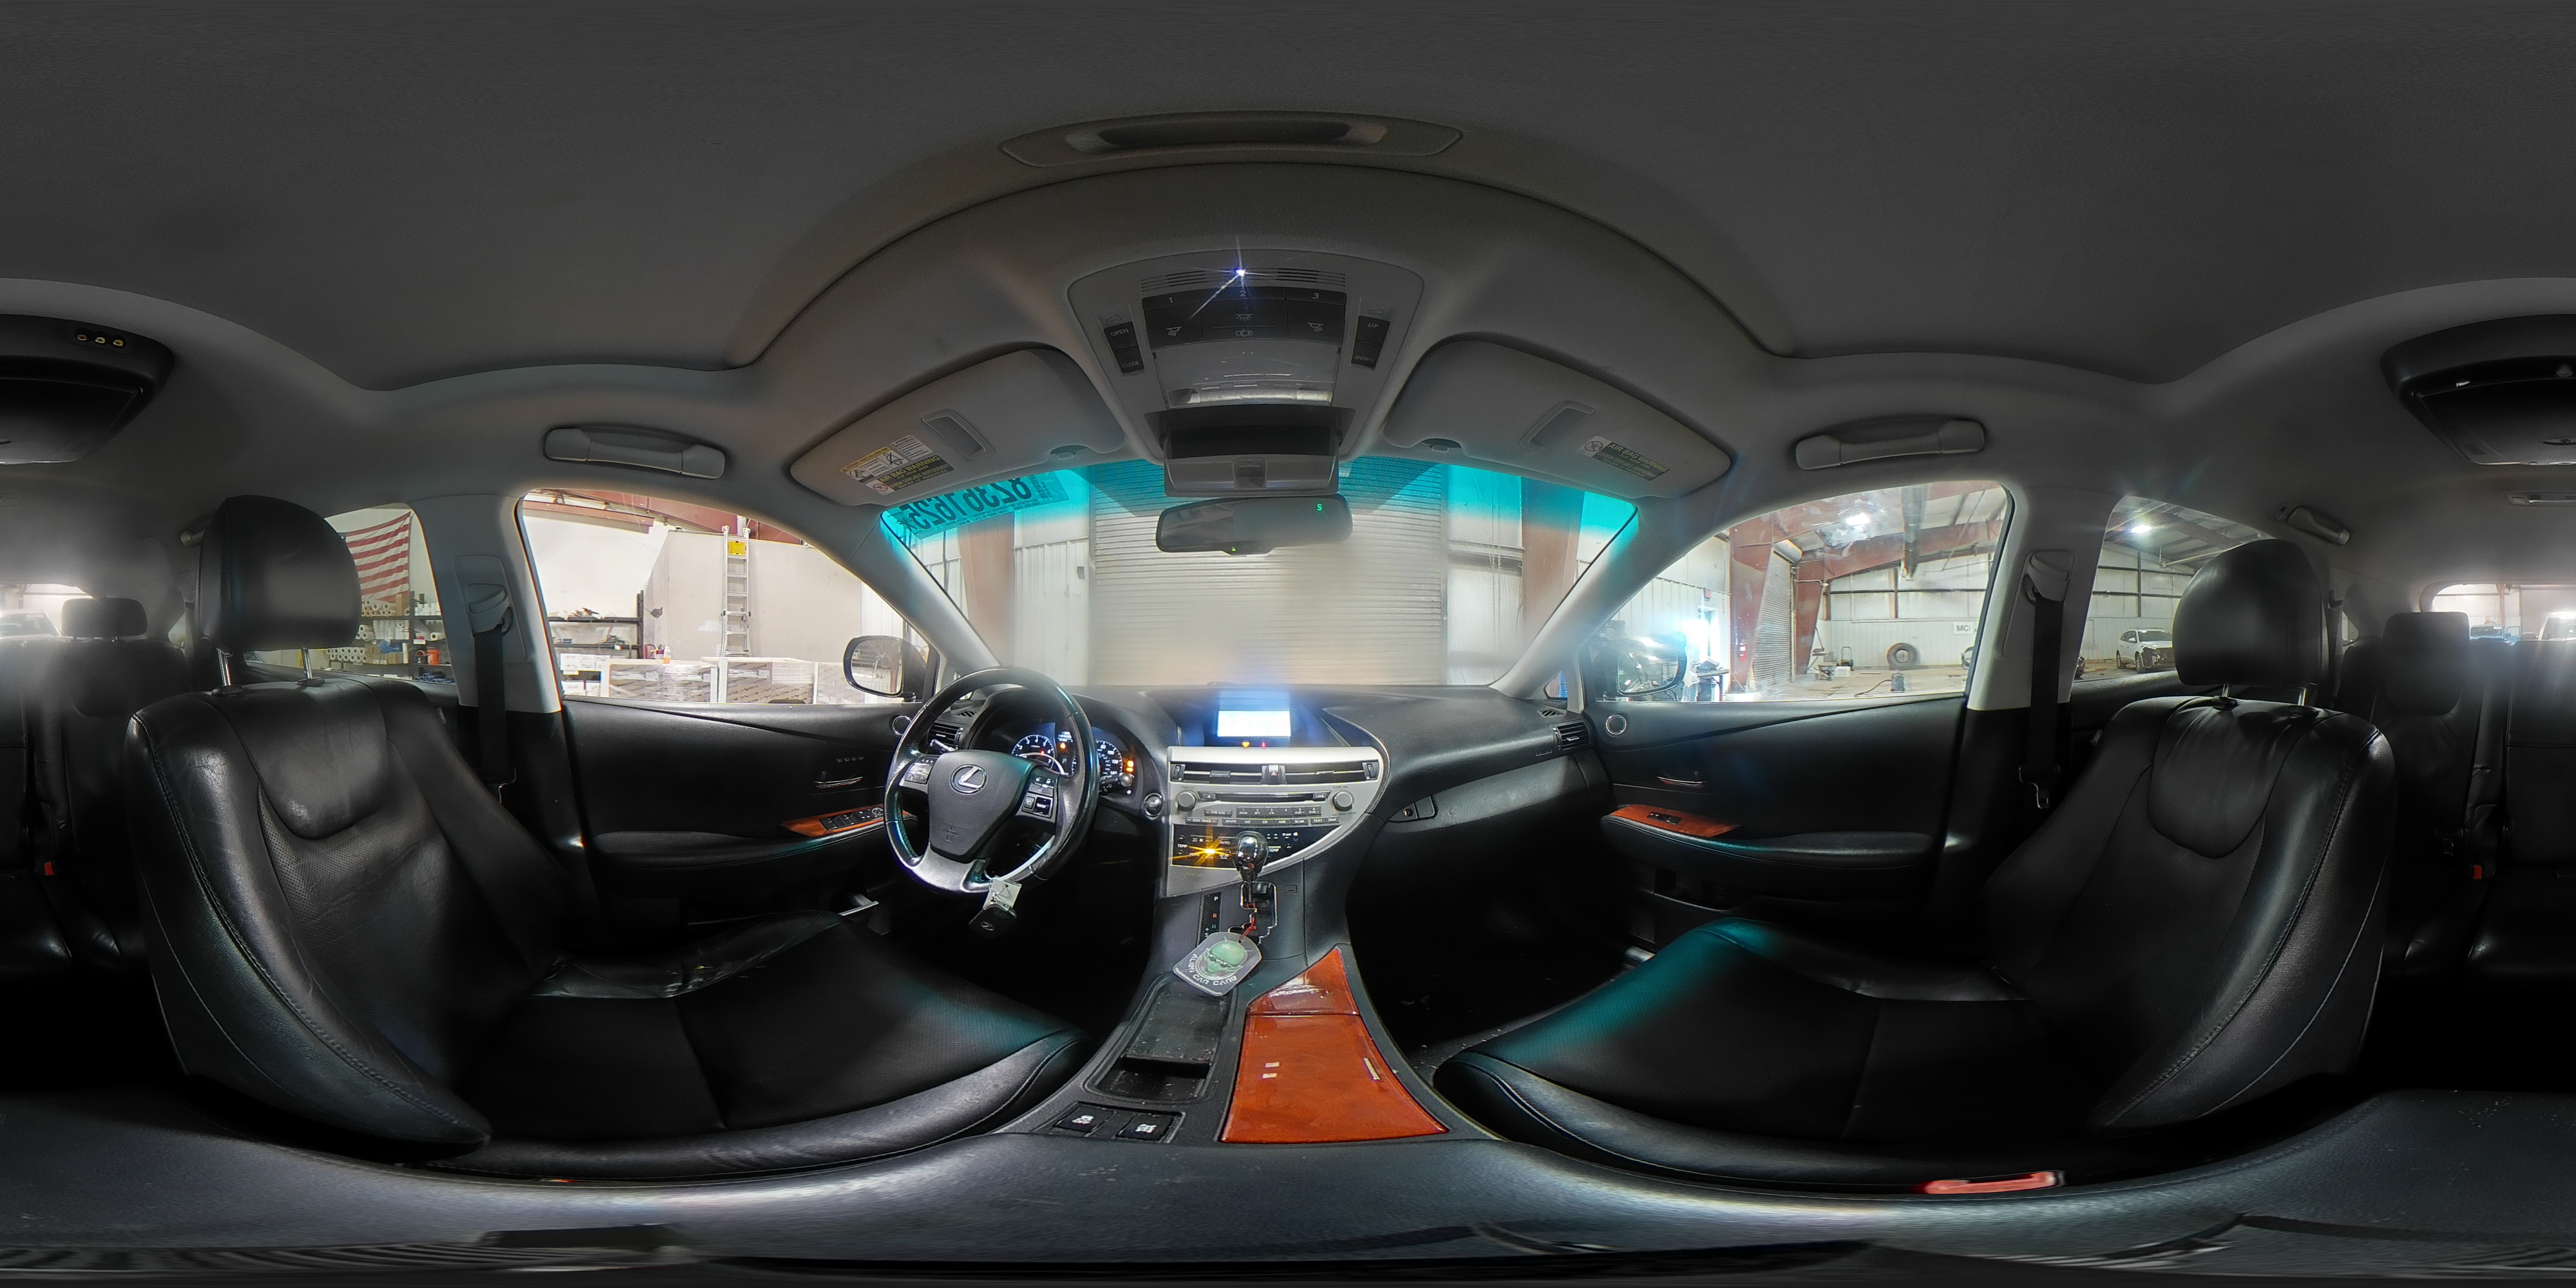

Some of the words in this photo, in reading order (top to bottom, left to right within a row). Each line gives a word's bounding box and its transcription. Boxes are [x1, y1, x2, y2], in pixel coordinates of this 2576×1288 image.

[1110, 328, 1129, 336] OPEN
[1608, 443, 1623, 451] AIR
[1622, 449, 1639, 459] BAG
[1638, 456, 1668, 472] WARNING
[891, 469, 906, 478] BAG
[904, 456, 941, 472] WARNING
[1188, 954, 1198, 973] ALIEN
[1192, 974, 1210, 985] CAR
[1213, 976, 1238, 986] CARE
